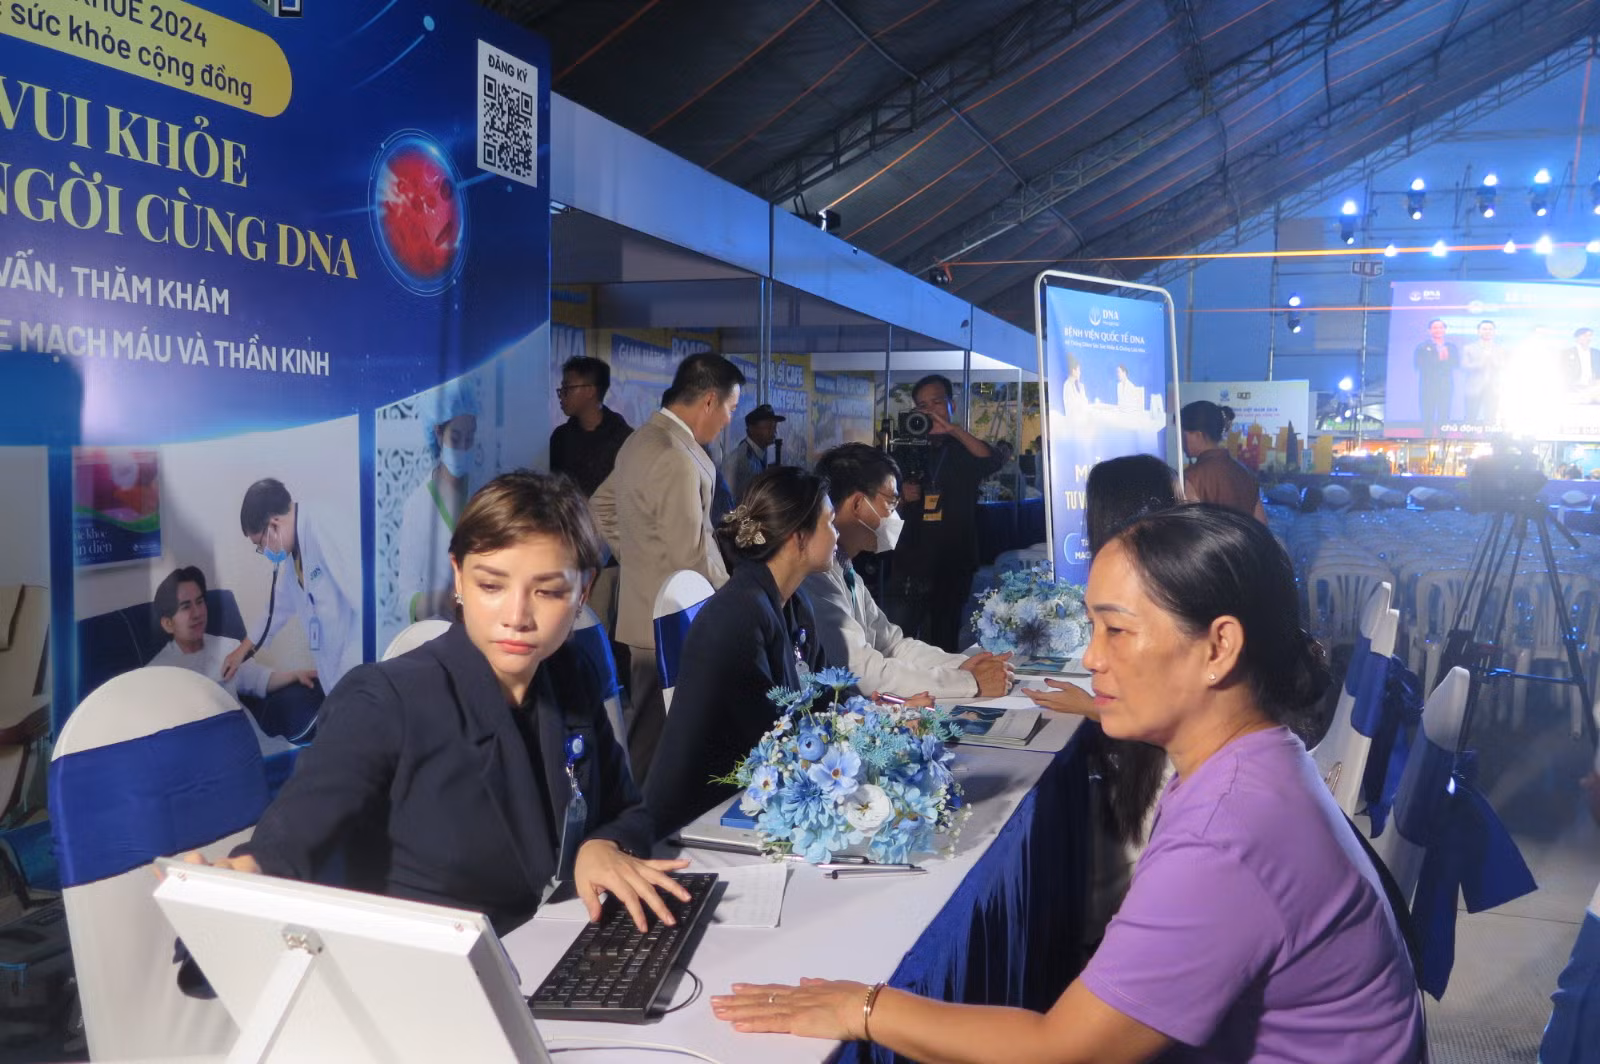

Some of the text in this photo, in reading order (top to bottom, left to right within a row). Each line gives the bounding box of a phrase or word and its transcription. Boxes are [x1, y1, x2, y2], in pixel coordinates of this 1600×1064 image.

[150, 5, 207, 48] 2024
[11, 3, 252, 104] sức khỏe cộng đồng
[488, 54, 528, 83] ĐĂNG KÝ
[0, 75, 248, 188] VUI KHỎE
[136, 187, 267, 262] CÙNG
[276, 223, 358, 280] DNA
[71, 265, 151, 305] THĂM
[158, 279, 229, 315] KHÁM
[1103, 309, 1119, 320] DNA
[20, 320, 105, 364] MẠCH
[113, 326, 171, 362] MÁU
[177, 332, 209, 366] VÀ
[214, 334, 276, 371] THẦN
[281, 347, 330, 376] KINH
[1130, 335, 1145, 344] DNA
